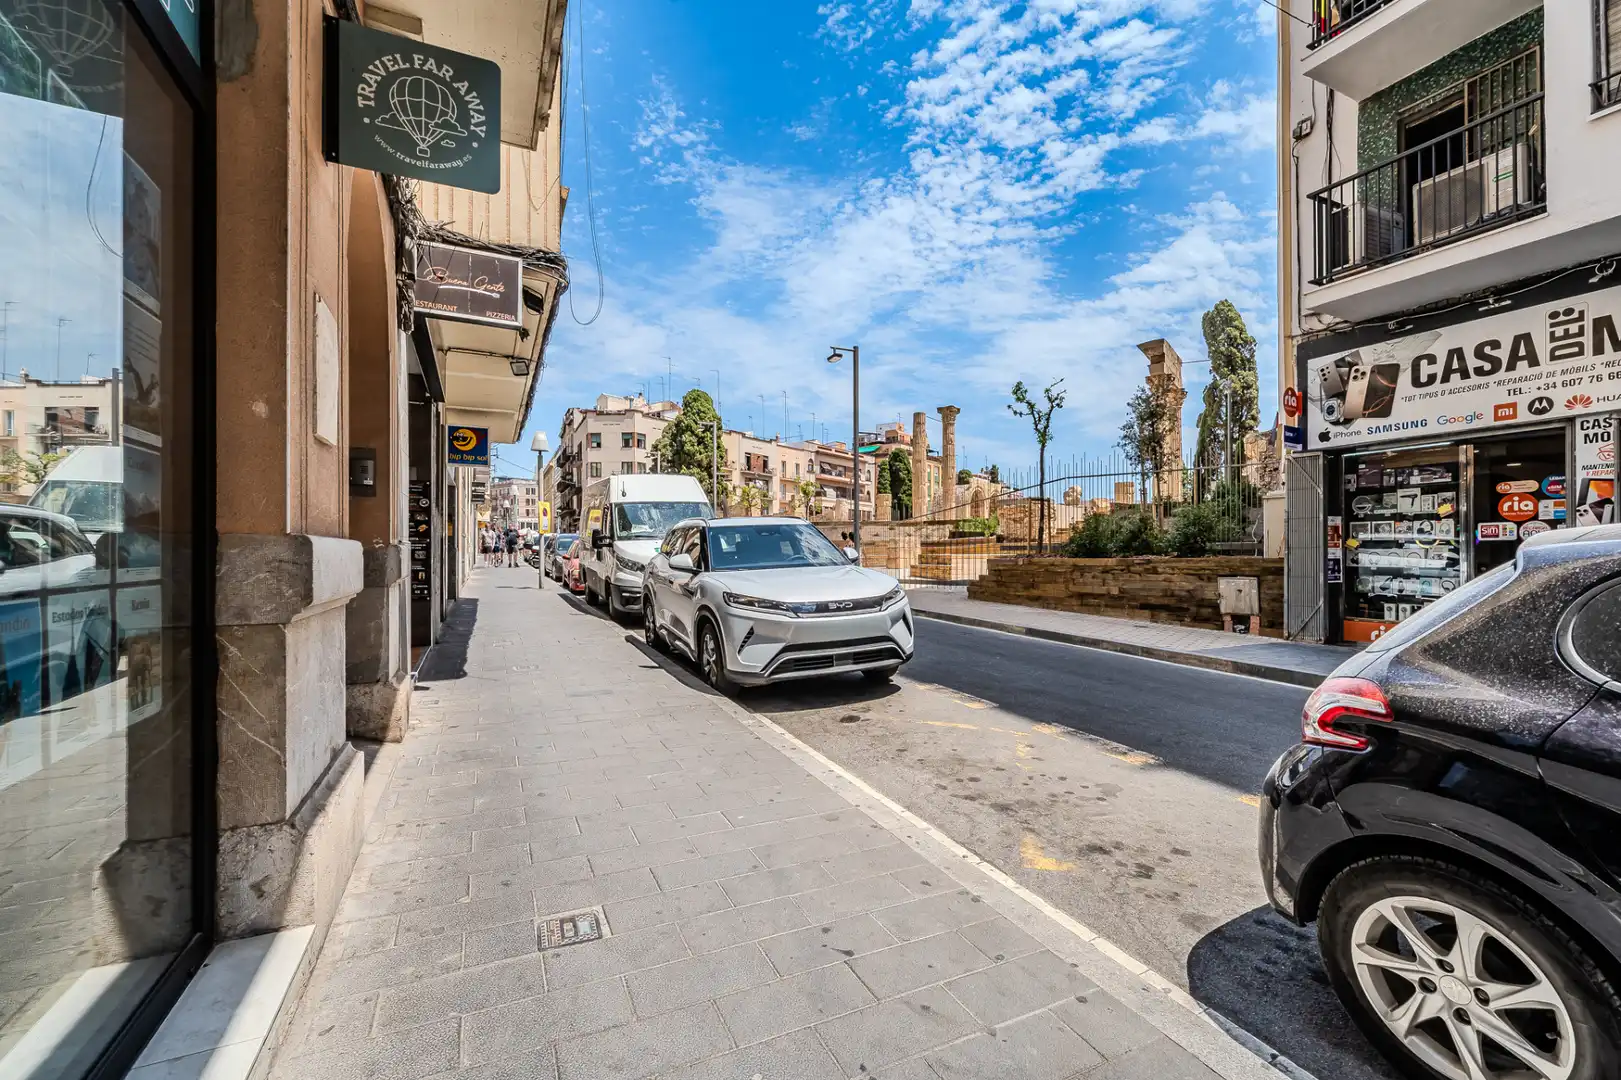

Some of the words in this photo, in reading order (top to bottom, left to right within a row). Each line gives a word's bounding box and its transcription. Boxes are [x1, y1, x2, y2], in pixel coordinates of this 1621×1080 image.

[357, 53, 411, 108] TRAVEL
[412, 54, 454, 81] FAR
[452, 80, 487, 138] AWAY
[374, 134, 473, 169] www.travelfaraway.es
[416, 266, 469, 285] Buena
[474, 276, 505, 293] Gente
[414, 300, 458, 312] ESTAURANT
[486, 311, 516, 321] PIZZERIA
[1411, 332, 1541, 388] CASA
[1548, 307, 1586, 362] DEL
[1419, 390, 1439, 400] TIPUS
[1545, 369, 1558, 379] DE
[1506, 386, 1532, 397] TEL.:
[1536, 381, 1557, 392] +34
[1561, 376, 1584, 388] 607
[1587, 373, 1603, 384] 76
[1284, 390, 1298, 407] ria
[1366, 418, 1428, 436] SAMSUNG
[1436, 411, 1484, 426] Google
[1333, 428, 1362, 439] iPhone
[1502, 496, 1534, 512] ria
[1481, 526, 1499, 535] sim
[828, 601, 853, 609] BYD
